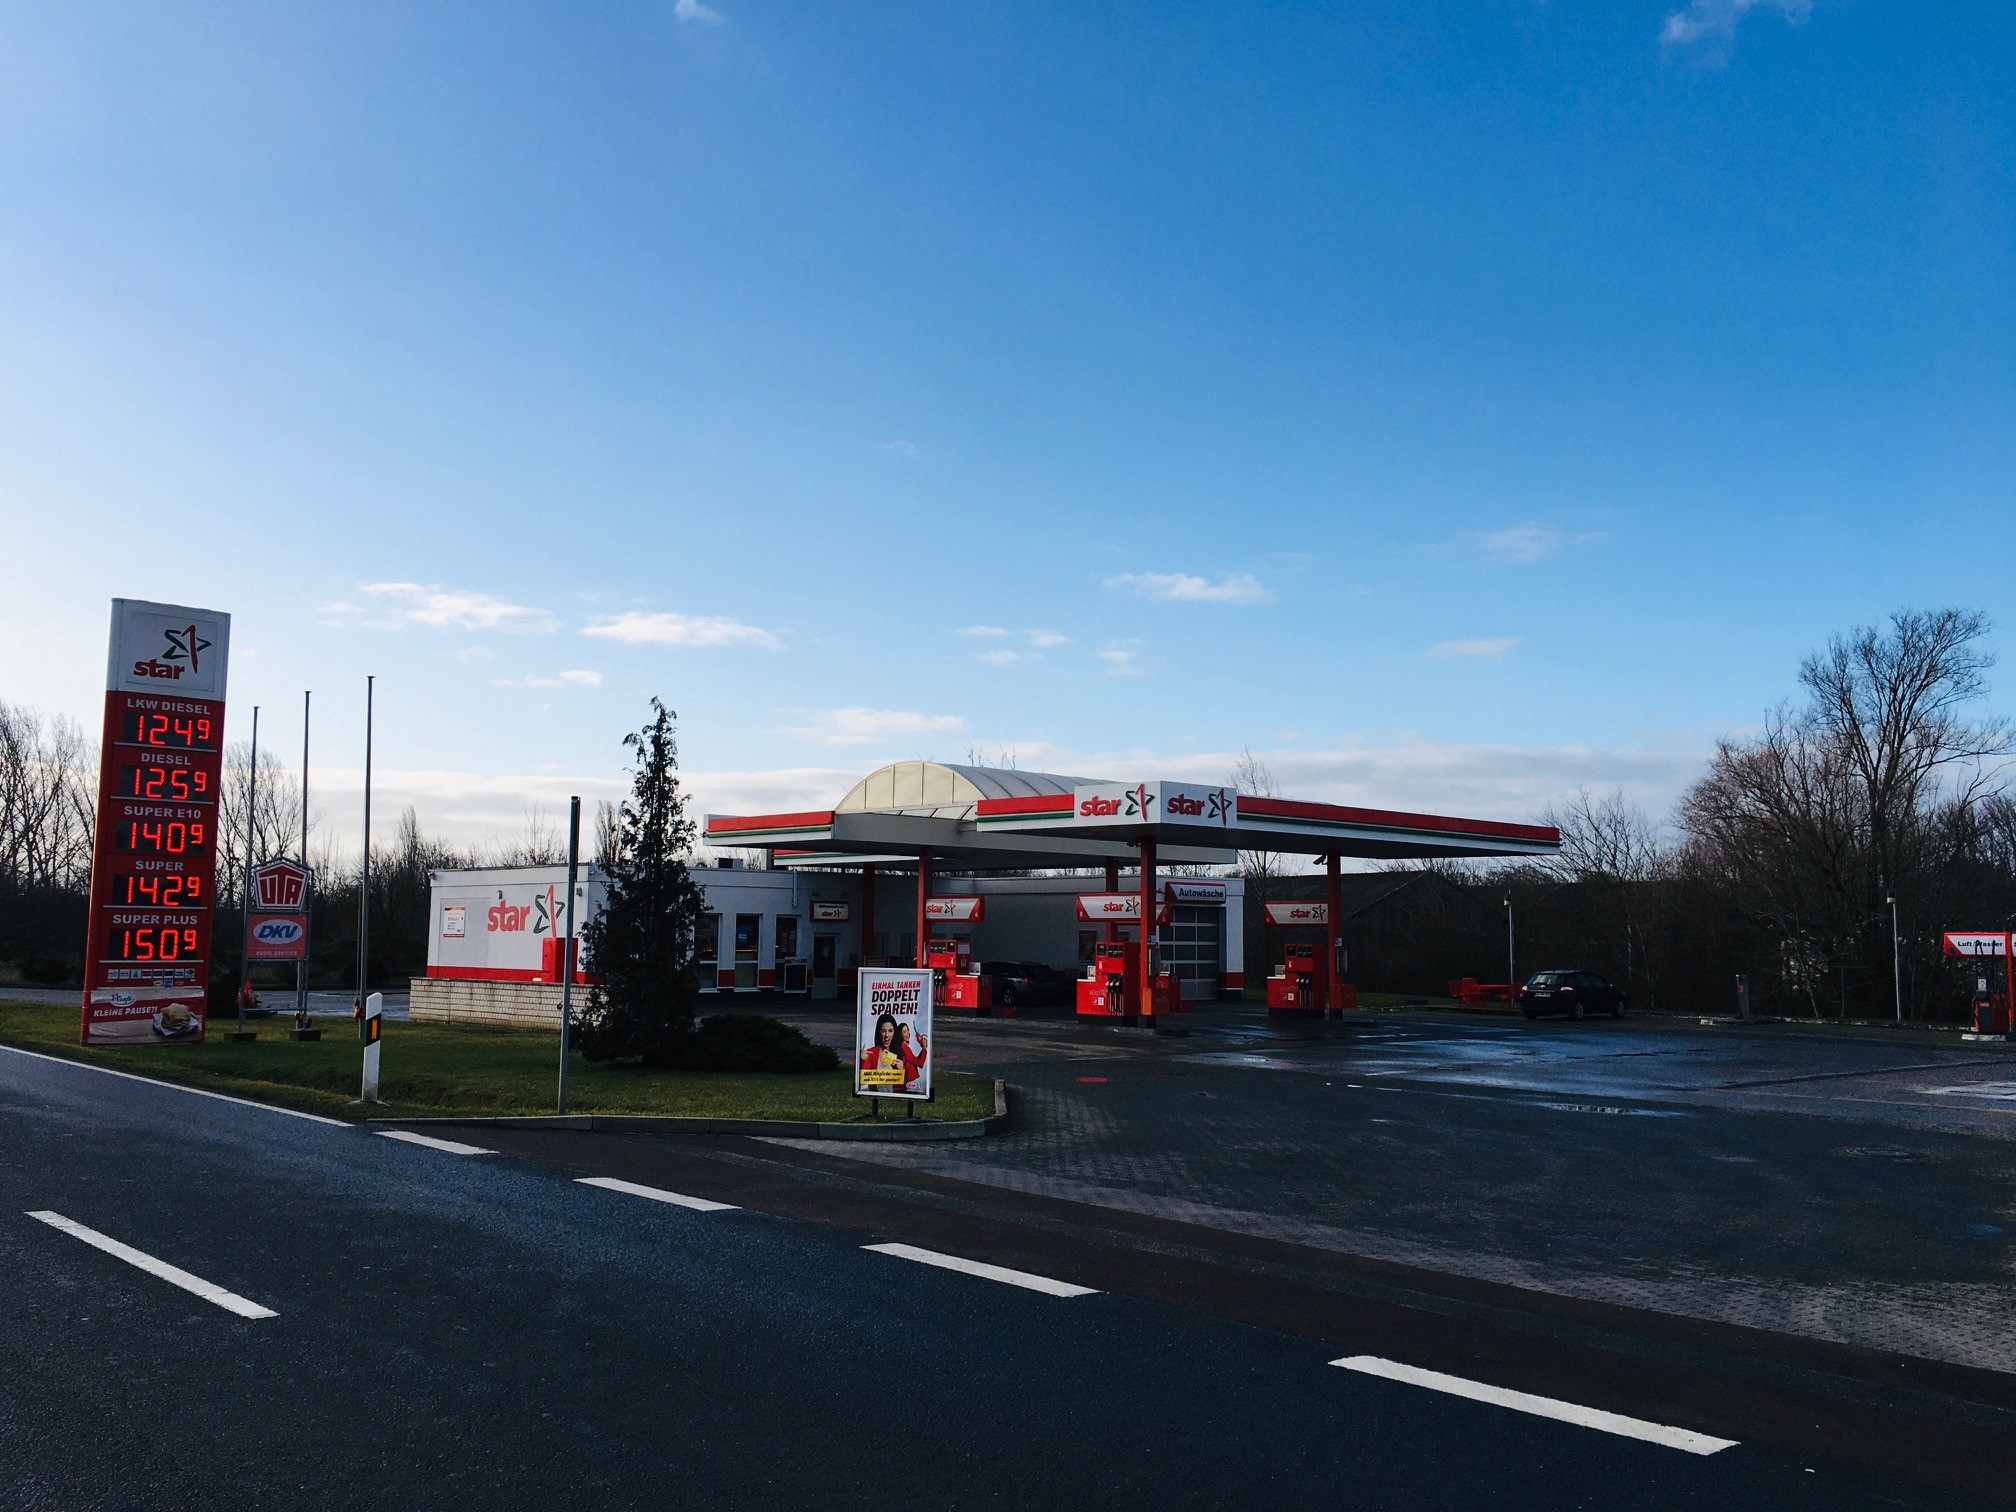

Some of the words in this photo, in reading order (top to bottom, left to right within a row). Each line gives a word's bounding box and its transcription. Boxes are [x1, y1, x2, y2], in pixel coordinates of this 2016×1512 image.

[133, 658, 185, 680] star
[127, 698, 158, 711] LKW
[162, 700, 211, 715] DIESEL
[141, 753, 192, 766] DIESEL
[1080, 795, 1121, 817] star
[1167, 793, 1206, 816] star
[124, 805, 173, 818] SUPER
[177, 808, 201, 819] E10
[135, 860, 184, 871] SUPER
[258, 864, 304, 906] UTA
[1179, 887, 1224, 899] Autowäsche
[926, 903, 943, 913] star
[1103, 902, 1124, 912] star
[1290, 908, 1311, 918] star
[113, 914, 160, 924] SUPER
[163, 915, 198, 925] PLUS
[487, 899, 530, 932] star
[258, 925, 299, 939] DKV
[871, 981, 895, 990] EINMAL
[896, 980, 921, 989] TANKEN
[871, 989, 921, 1003] DOPPELT
[93, 1008, 123, 1017] KLEINE
[124, 1005, 158, 1015] PAUSE?!
[870, 1002, 919, 1016] SPAREN!
